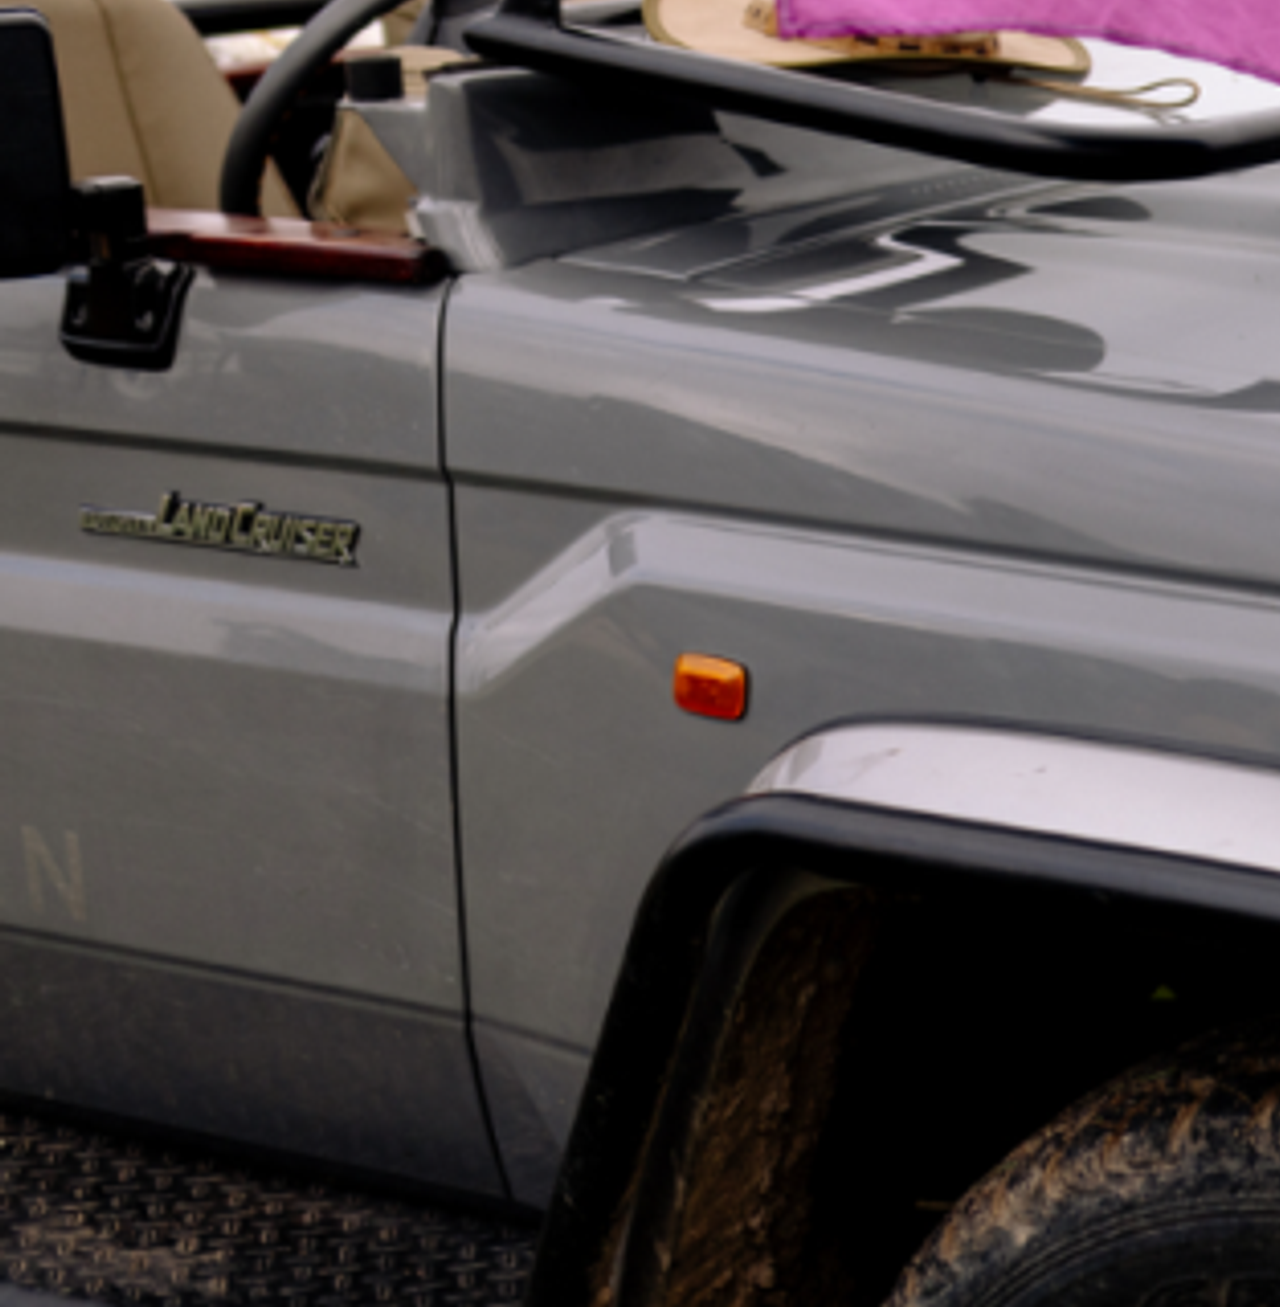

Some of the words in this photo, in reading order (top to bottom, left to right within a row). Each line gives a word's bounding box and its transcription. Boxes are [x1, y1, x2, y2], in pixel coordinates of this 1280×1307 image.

[156, 491, 232, 546] LAND
[231, 502, 359, 567] CRUISER
[20, 825, 87, 921] N
